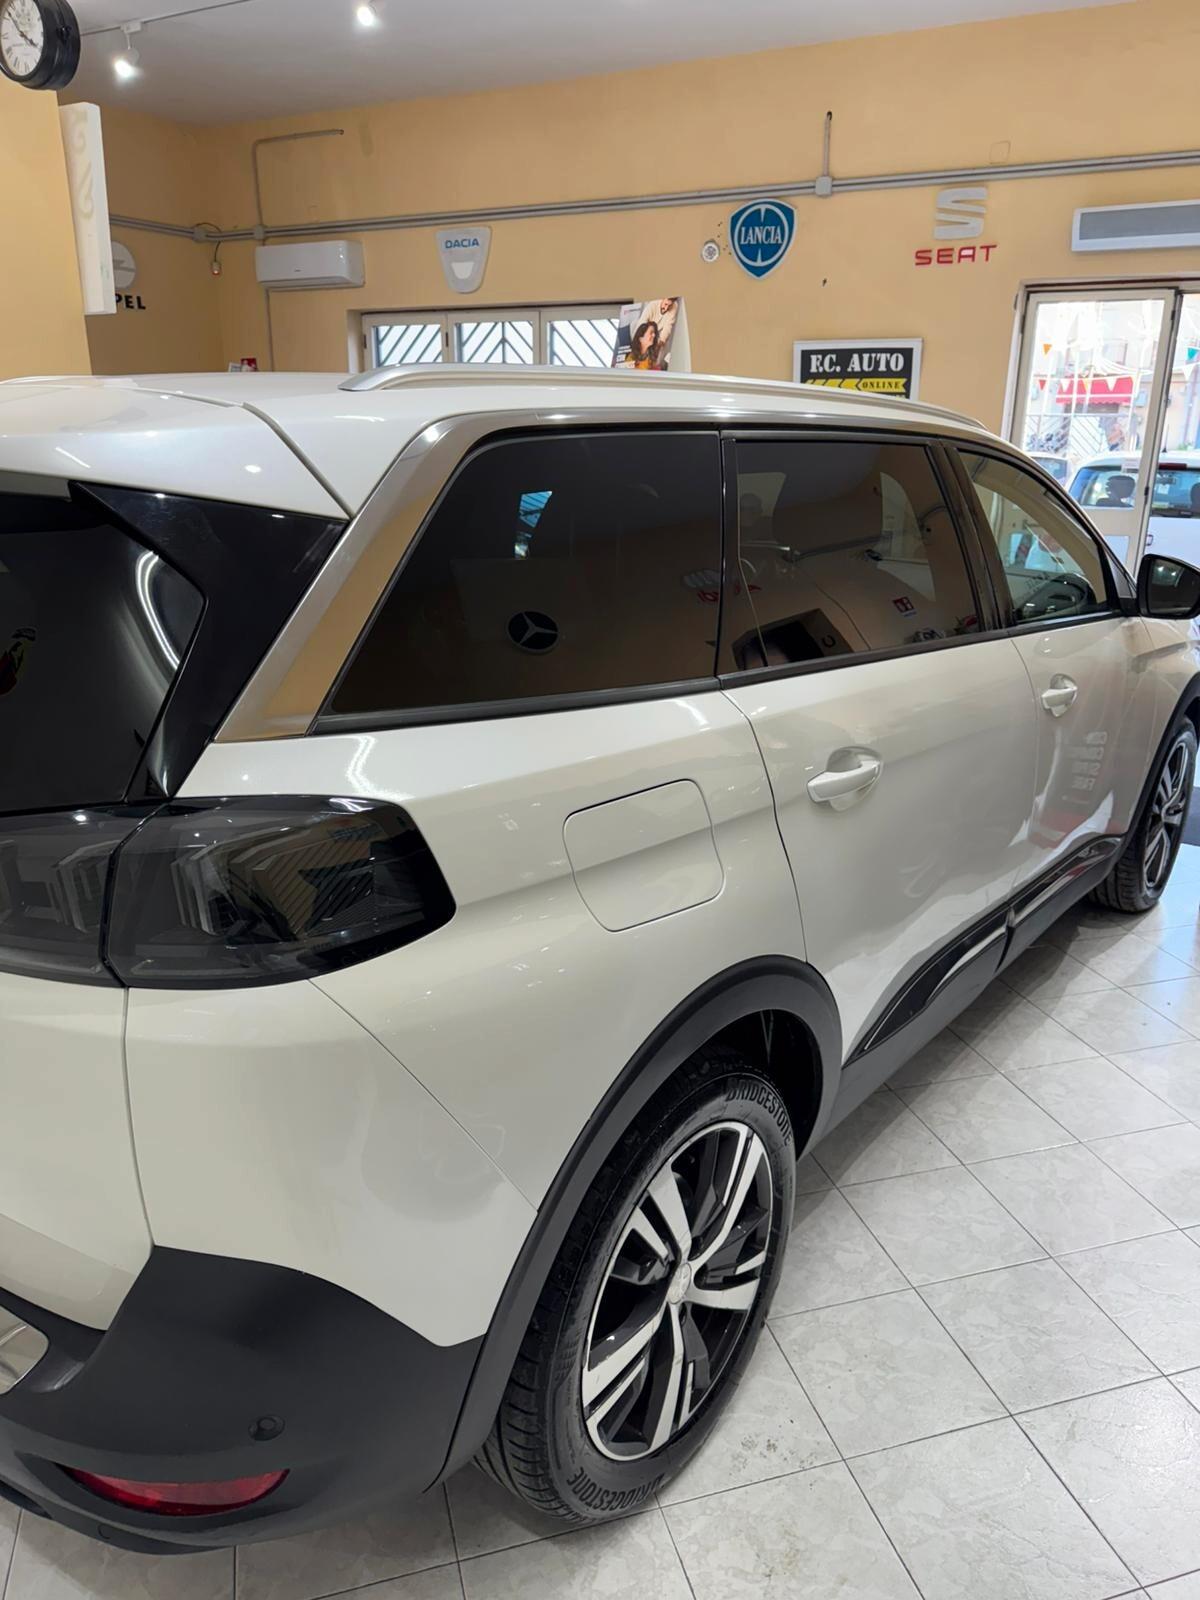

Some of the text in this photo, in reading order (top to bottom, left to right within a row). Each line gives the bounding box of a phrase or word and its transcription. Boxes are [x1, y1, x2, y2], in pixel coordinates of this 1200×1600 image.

[445, 238, 480, 249] DACIA
[740, 225, 783, 245] LANCIA
[915, 244, 998, 266] SEAT
[115, 292, 147, 311] PEL
[809, 352, 905, 373] F.C. AUTO
[861, 380, 902, 390] ONLINE
[725, 1079, 793, 1147] BRIDGESTONE
